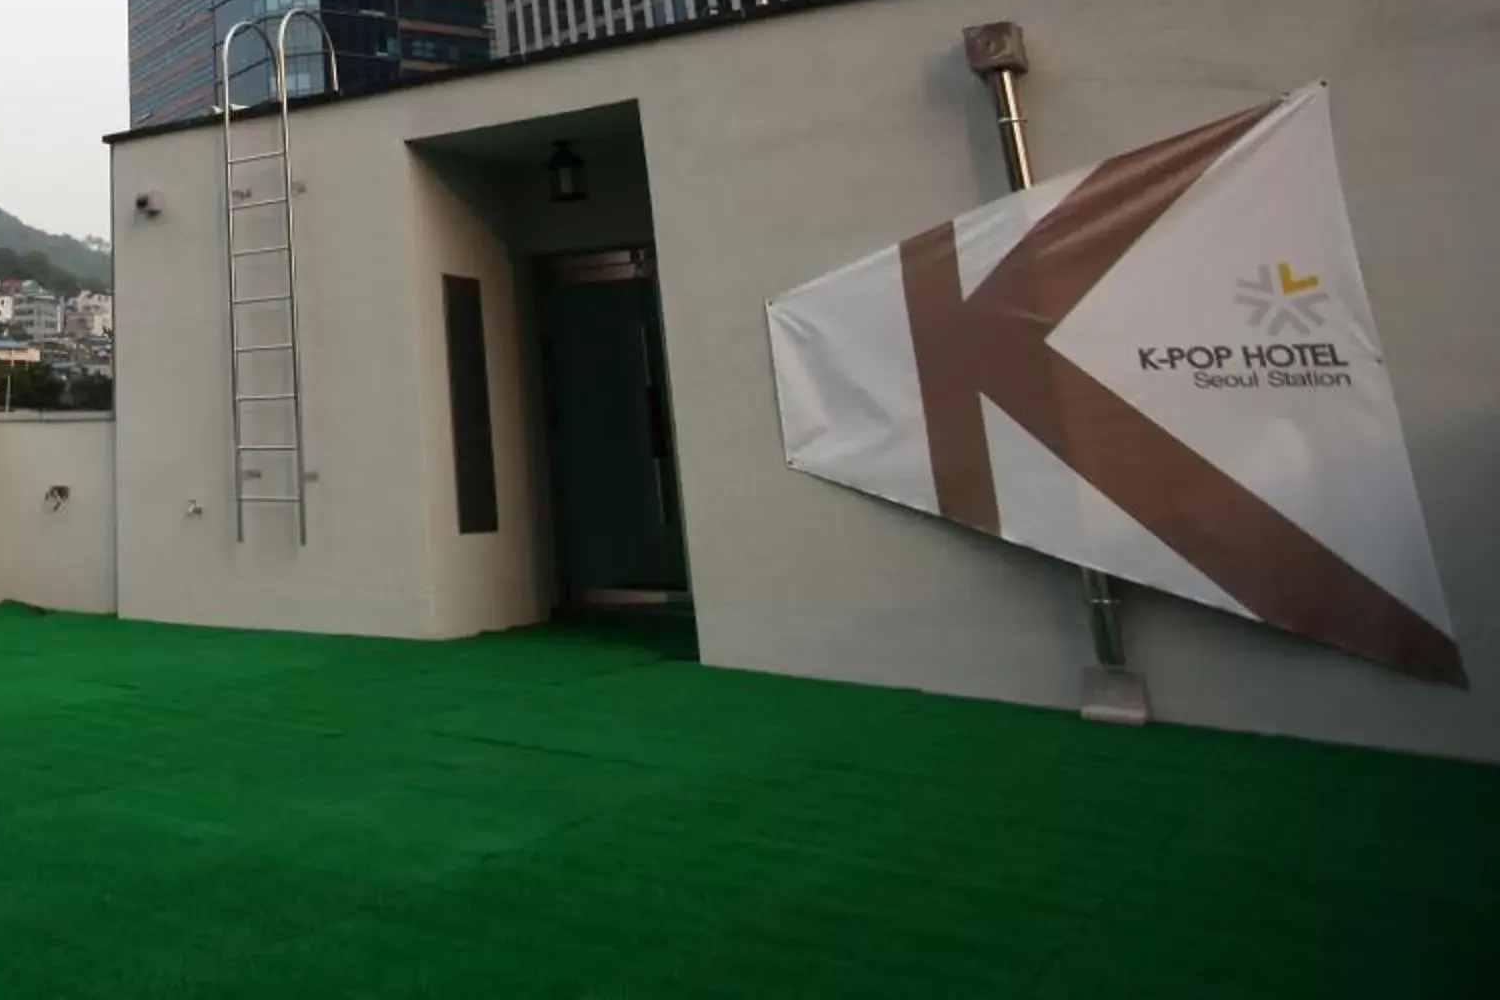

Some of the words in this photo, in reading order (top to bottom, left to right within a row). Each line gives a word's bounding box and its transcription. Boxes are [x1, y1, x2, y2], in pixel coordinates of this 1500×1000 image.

[1137, 346, 1233, 371] K-POP
[1243, 343, 1350, 369] HOTEL
[1193, 371, 1259, 389] Seoul
[1267, 369, 1352, 388] Station
